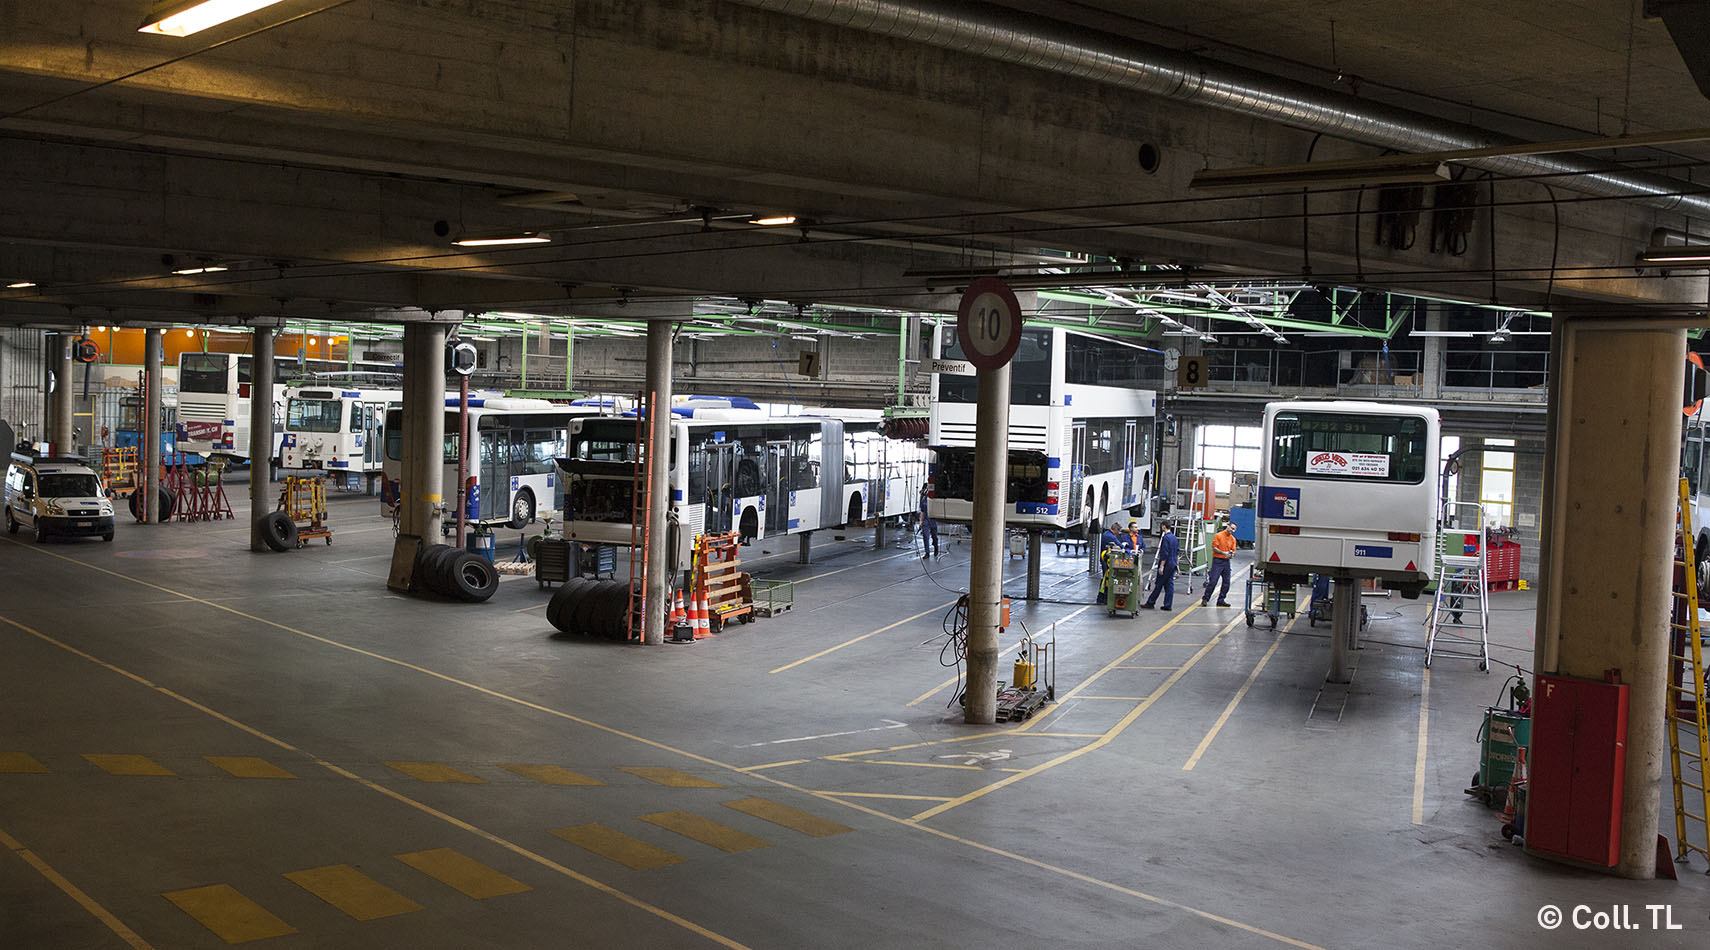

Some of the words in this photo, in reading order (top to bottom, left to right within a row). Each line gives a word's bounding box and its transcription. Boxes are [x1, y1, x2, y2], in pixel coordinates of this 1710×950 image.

[979, 308, 1000, 341] 10
[372, 353, 400, 361] Correctif
[806, 354, 814, 373] 7
[932, 362, 966, 373] Préventif
[1187, 360, 1199, 384] 8
[1036, 507, 1049, 515] 512
[1546, 684, 1556, 697] F
